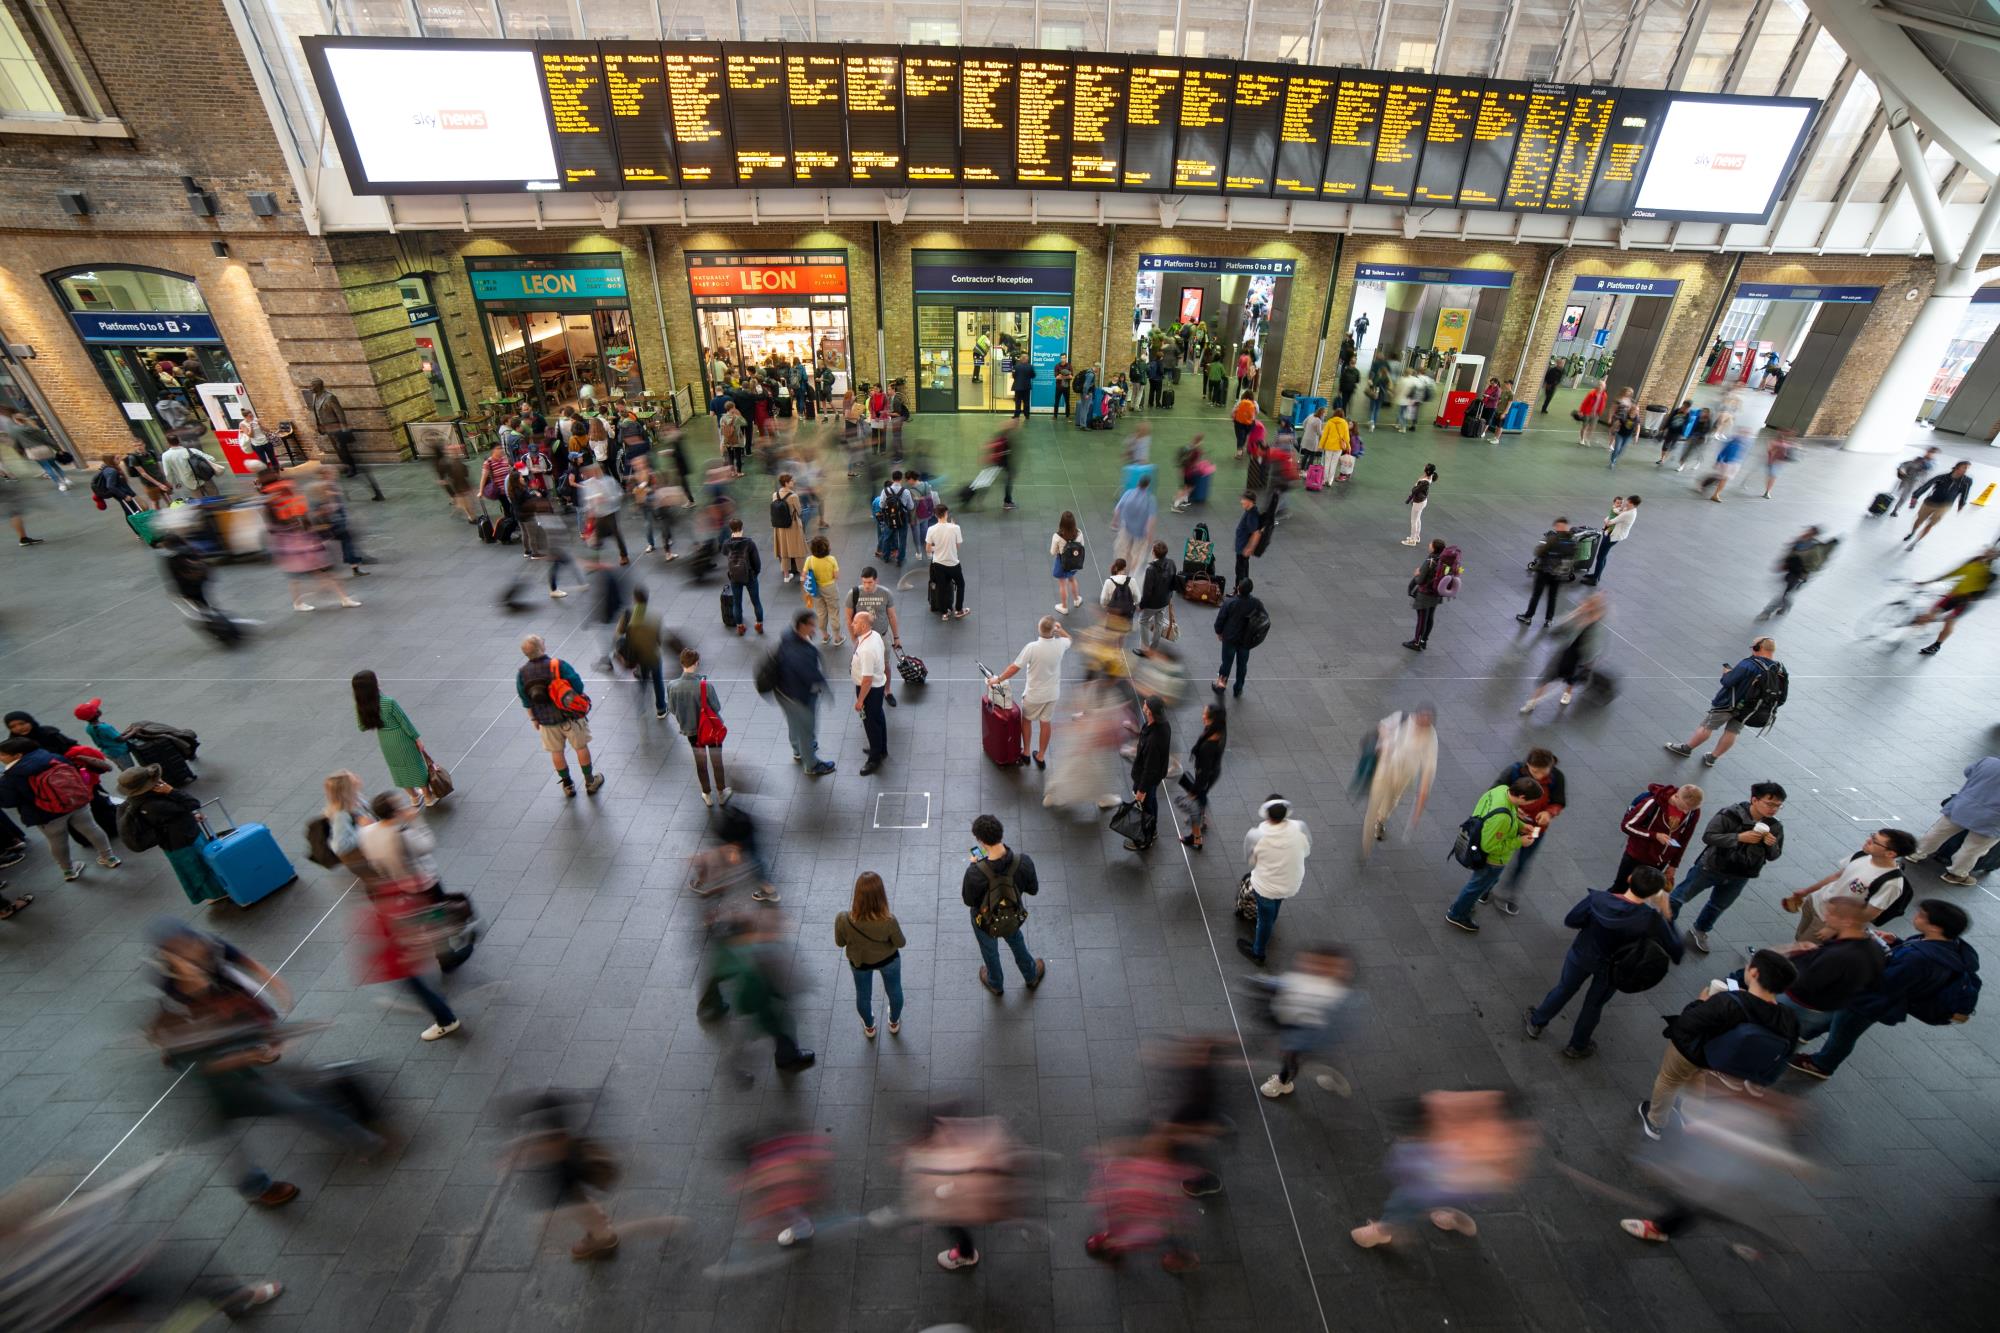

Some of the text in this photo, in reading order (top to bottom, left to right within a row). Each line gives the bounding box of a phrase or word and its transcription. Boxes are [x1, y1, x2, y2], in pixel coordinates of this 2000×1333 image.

[544, 64, 586, 72] Peterborough
[668, 64, 691, 72] Royston
[1076, 73, 1102, 81] Edinburgh
[1288, 85, 1321, 94] Peterborough
[1436, 96, 1458, 104] Edinburgh
[412, 112, 484, 127] sky news
[1714, 156, 1743, 167] news
[521, 274, 577, 294] LEON
[740, 270, 796, 290] LEON
[997, 275, 1032, 284] Reception
[98, 322, 139, 331] Platforms
[140, 323, 146, 331] 0
